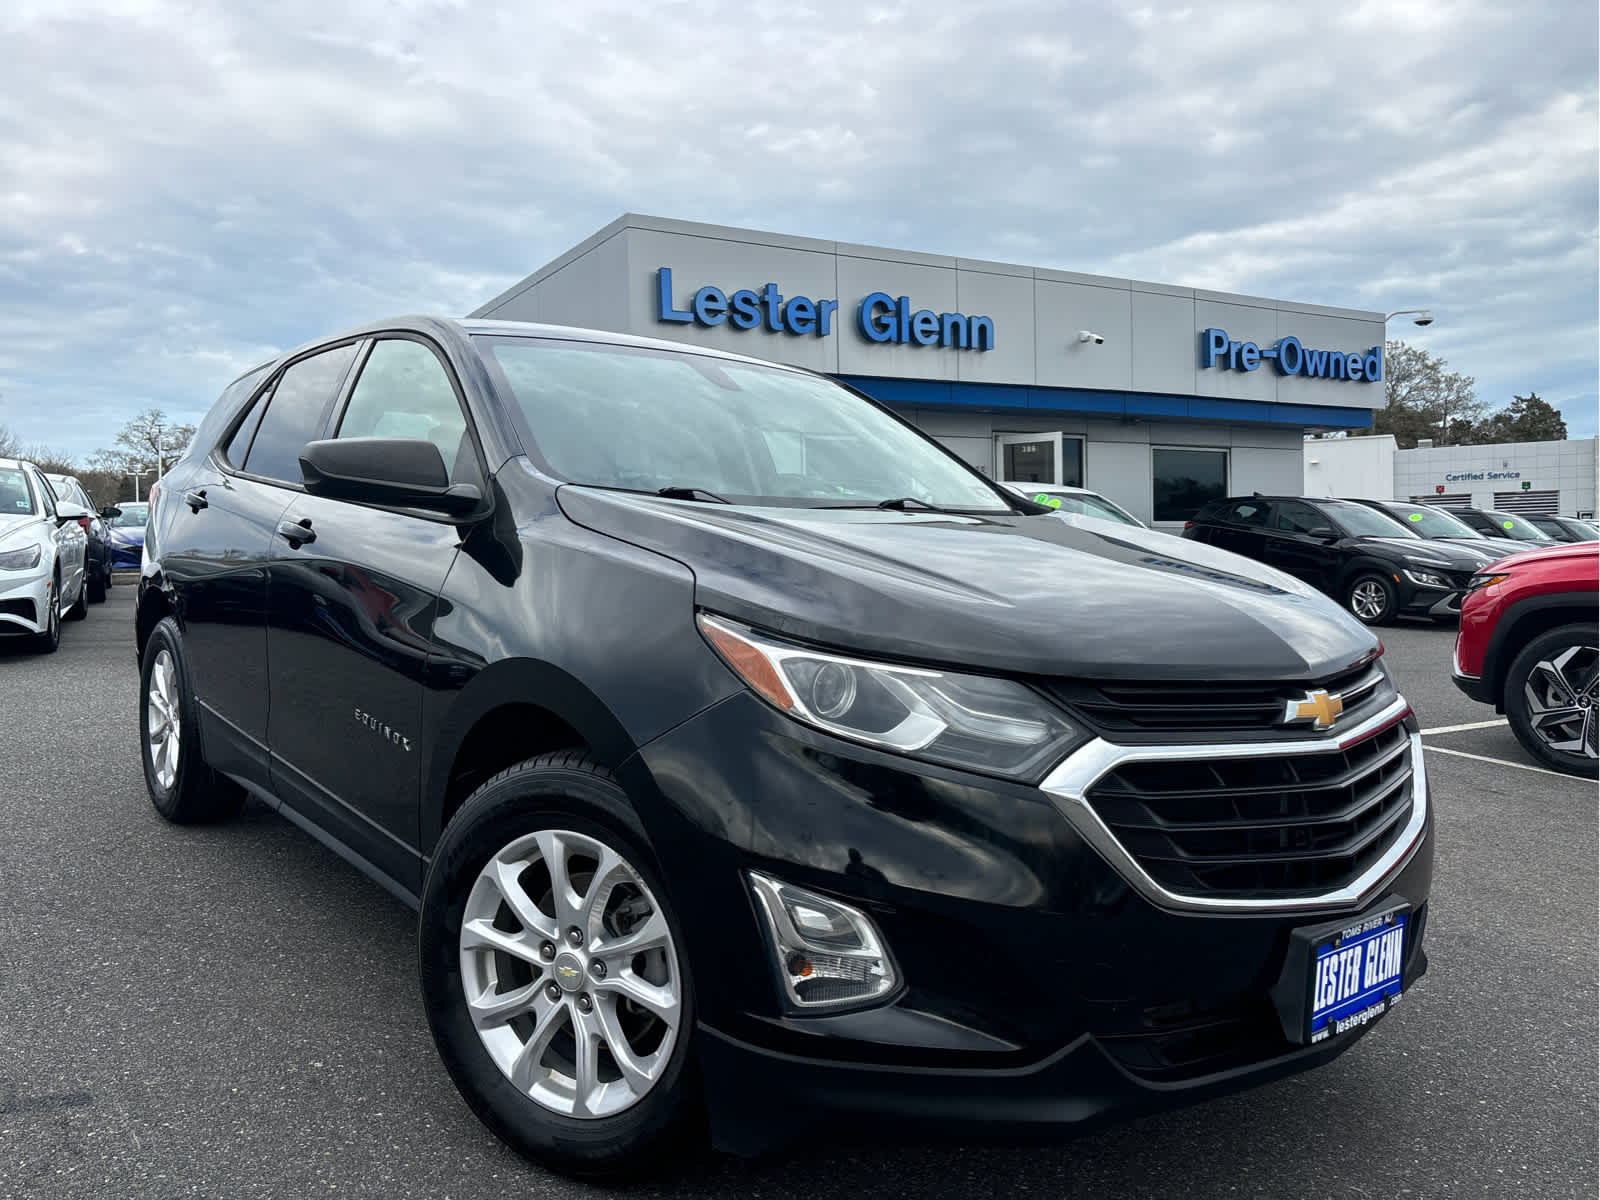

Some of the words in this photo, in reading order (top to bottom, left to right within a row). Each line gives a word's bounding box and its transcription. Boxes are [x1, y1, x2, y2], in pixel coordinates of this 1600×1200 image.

[656, 267, 838, 337] Lester
[857, 291, 994, 351] Glenn
[1201, 327, 1382, 382] Pre-Owned
[1445, 472, 1484, 481] Certified
[1487, 471, 1520, 480] Service
[354, 707, 412, 752] EQUINOX
[1341, 924, 1362, 940] TOMS
[1313, 945, 1363, 1013] LESTER
[1364, 927, 1403, 989] GLENN
[1335, 1002, 1385, 1034] lesterglenn
